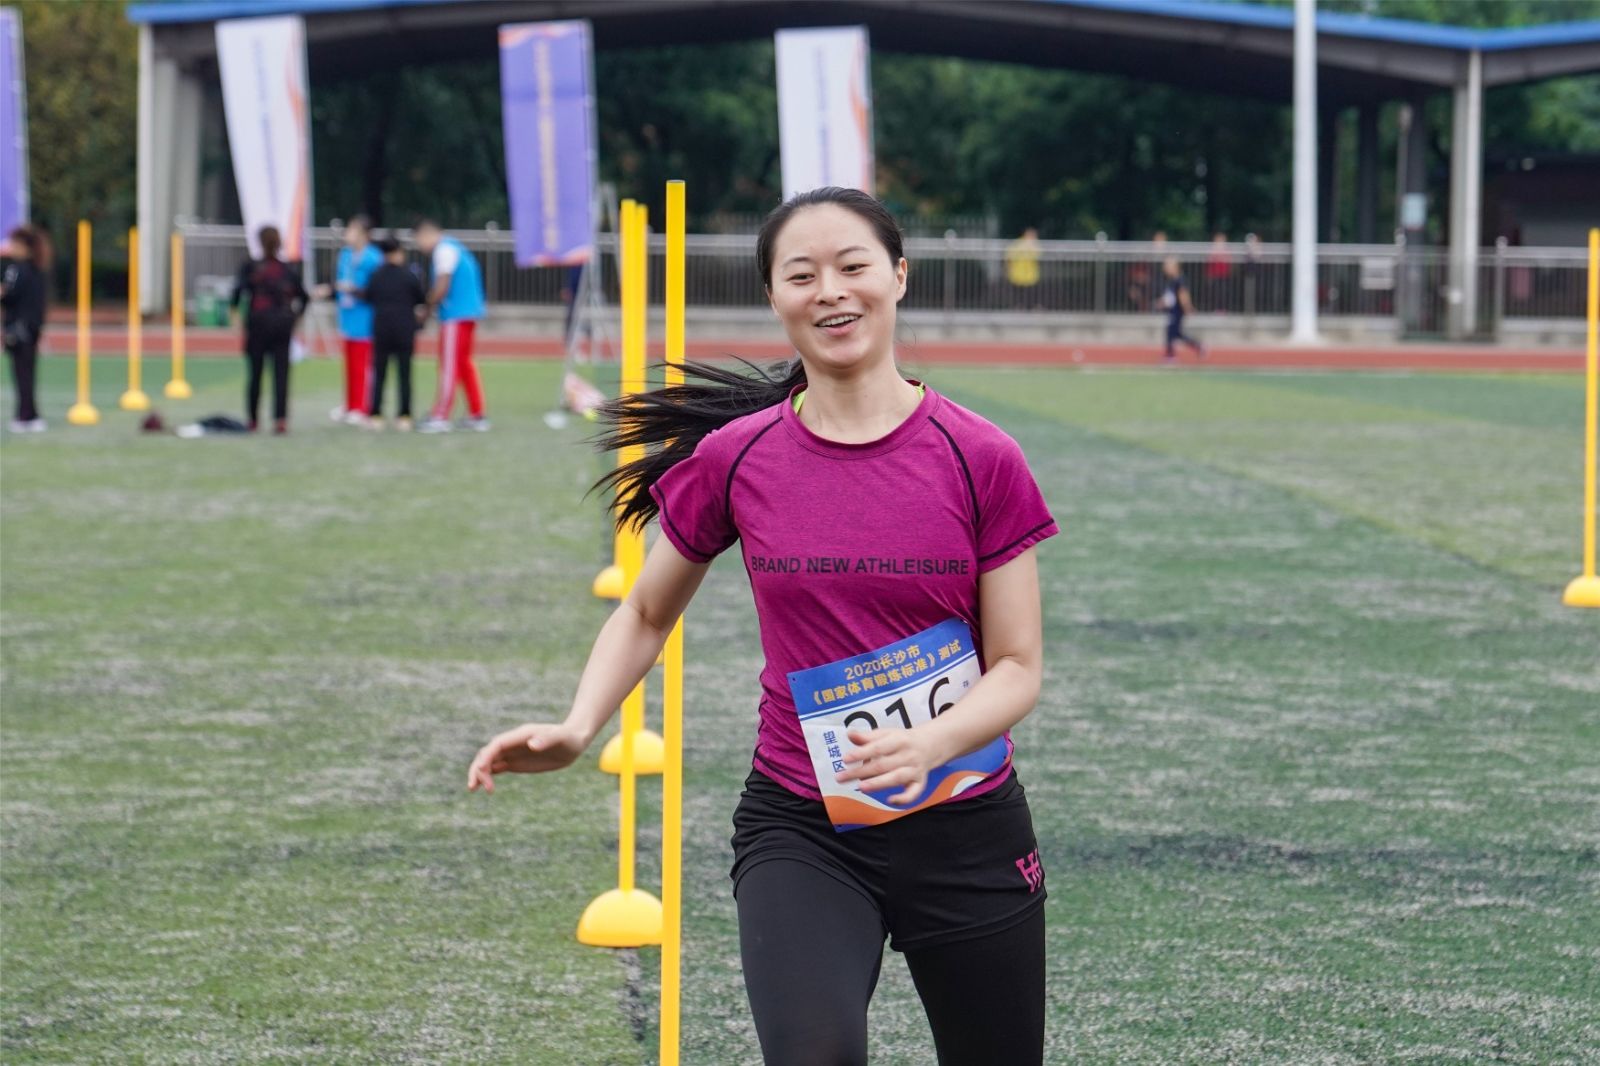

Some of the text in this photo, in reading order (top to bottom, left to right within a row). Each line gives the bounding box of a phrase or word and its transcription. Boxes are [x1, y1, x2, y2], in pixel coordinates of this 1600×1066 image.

[751, 556, 970, 575] BRAND NEW ATHLEISURE
[844, 645, 920, 681] 2020长沙市
